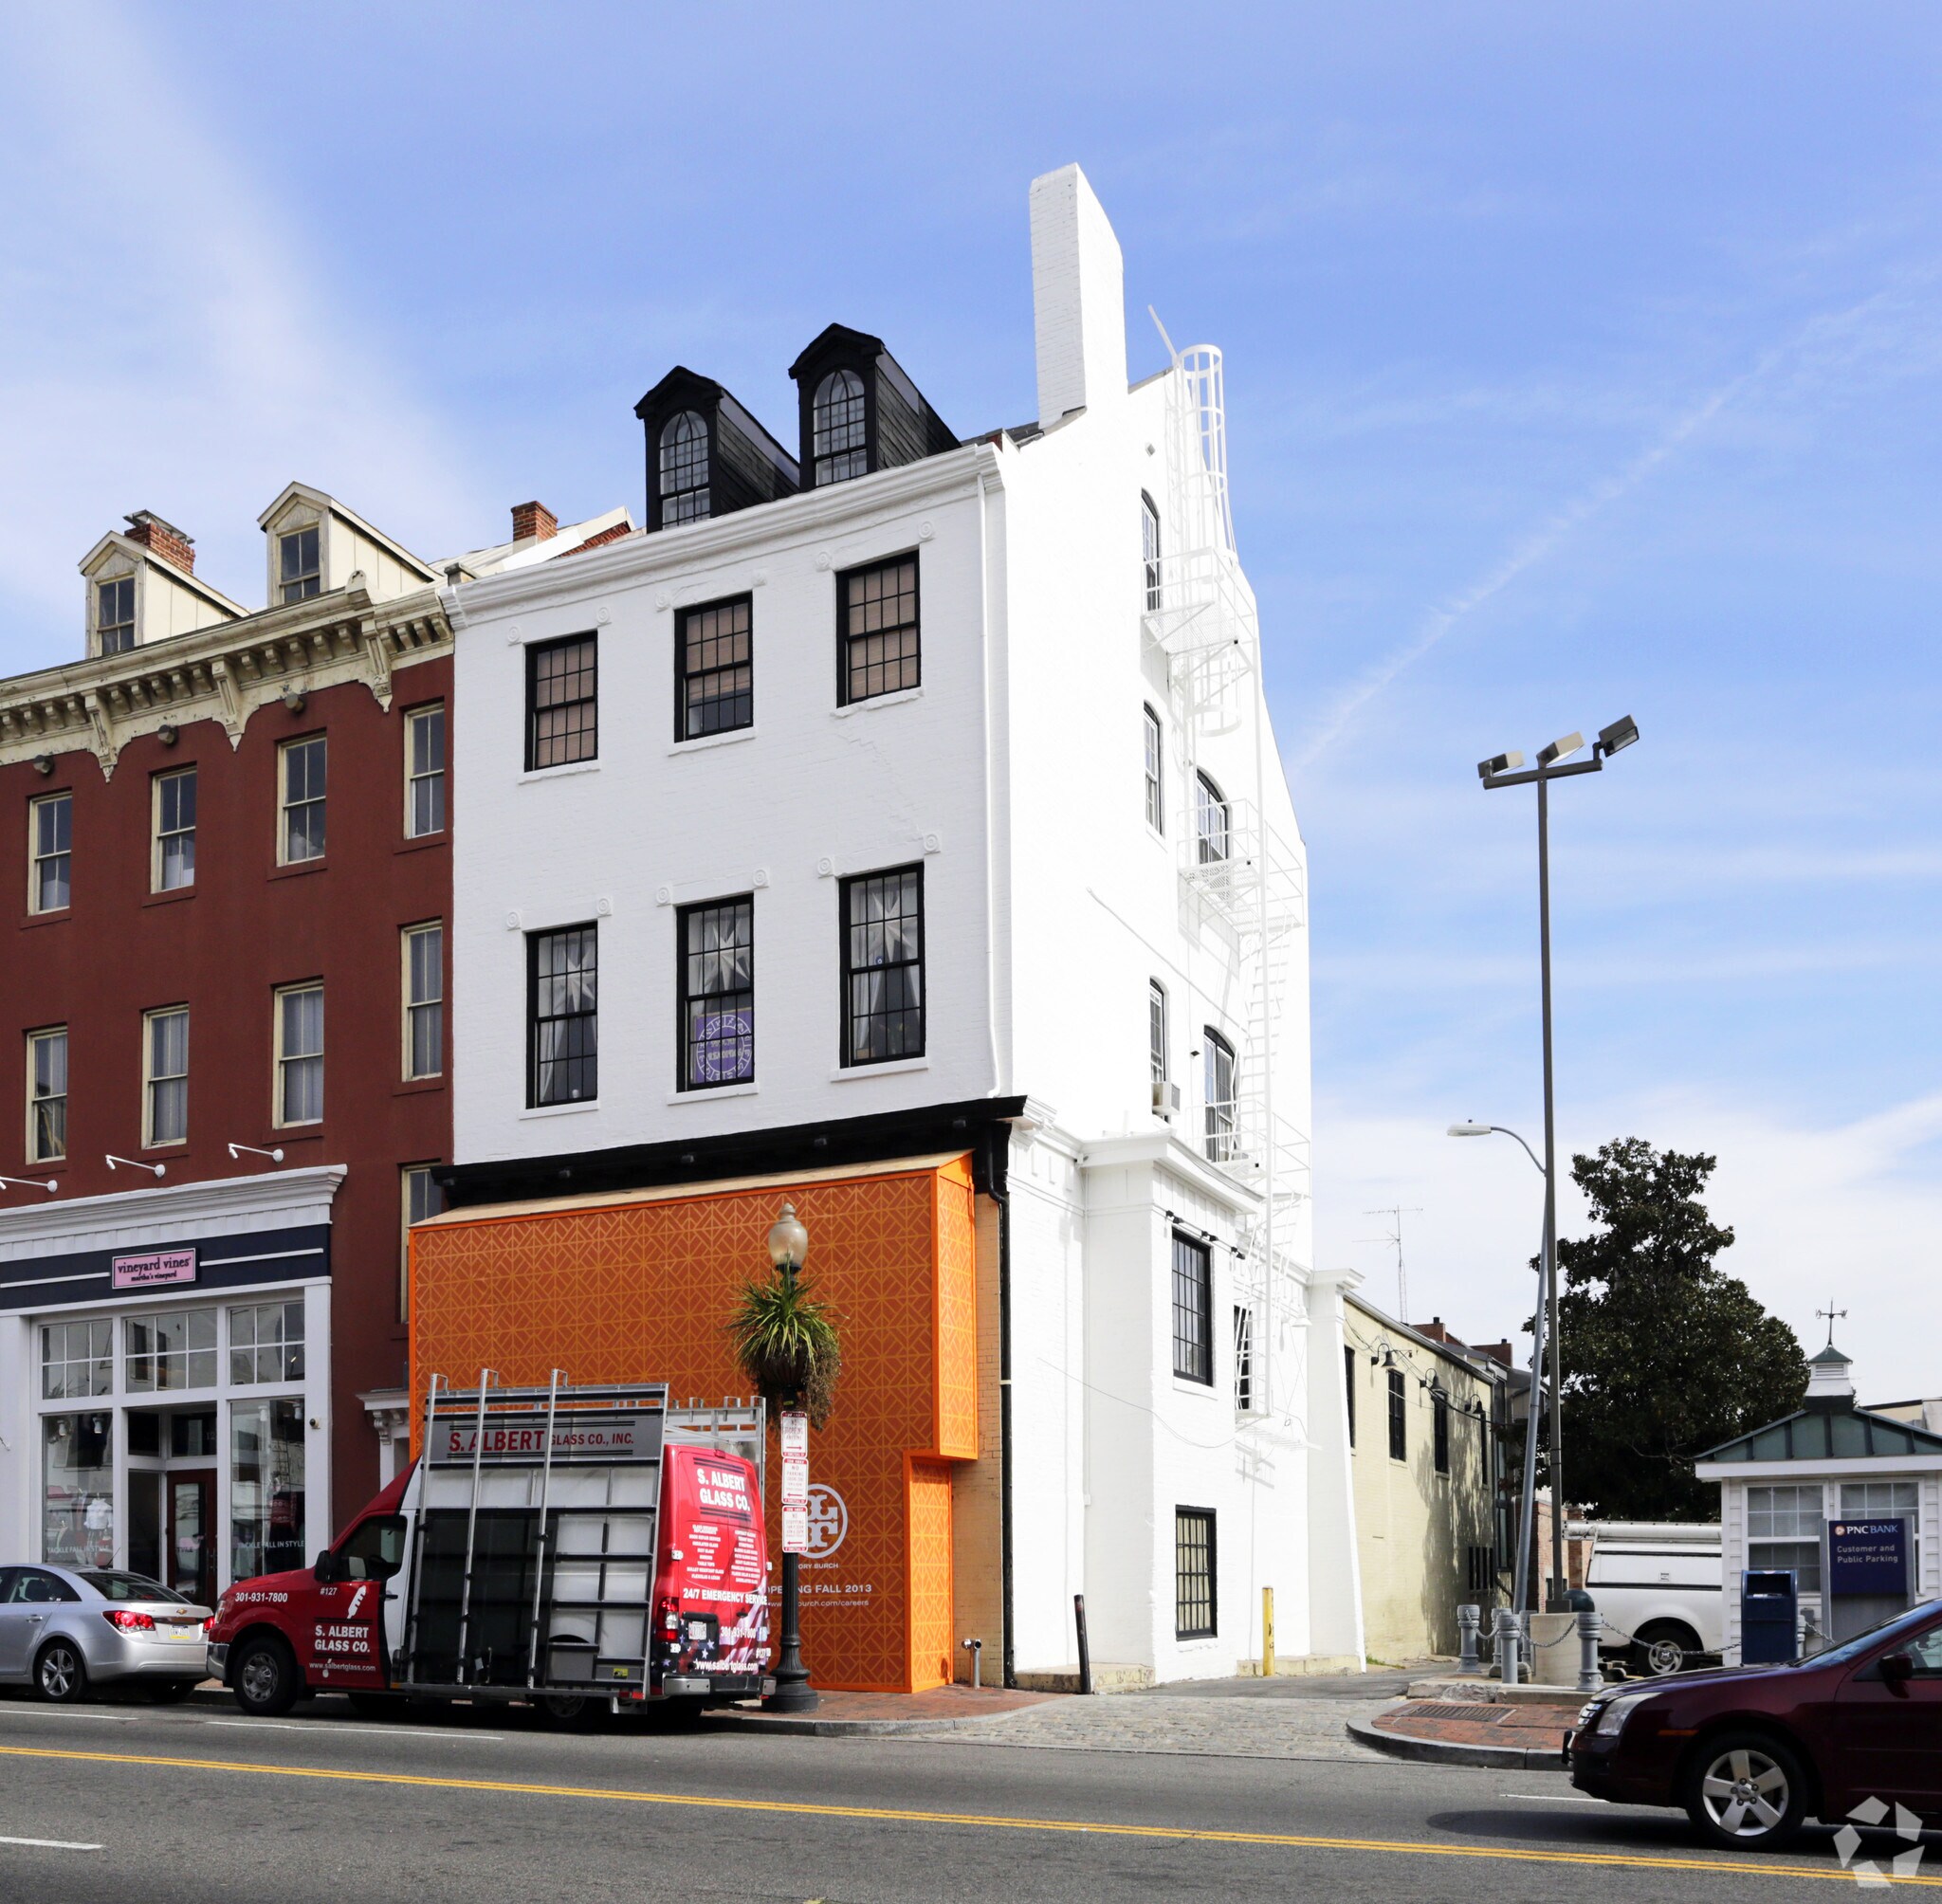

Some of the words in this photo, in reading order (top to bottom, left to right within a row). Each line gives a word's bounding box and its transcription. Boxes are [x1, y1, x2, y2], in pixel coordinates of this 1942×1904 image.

[118, 1256, 160, 1275] vineyard
[131, 1272, 154, 1281] martha's
[155, 1270, 177, 1280] vineyard
[449, 1432, 465, 1452] S.
[612, 1433, 634, 1445] INC.
[697, 1468, 709, 1485] S.
[711, 1471, 745, 1492] ALBERT
[700, 1488, 734, 1508] GLASS
[735, 1494, 751, 1511] CO.
[1846, 1525, 1869, 1534] PNC
[1870, 1525, 1898, 1533] BANK
[1837, 1545, 1878, 1553] Customer
[1879, 1544, 1895, 1552] and
[1865, 1555, 1898, 1564] Parking
[235, 1592, 288, 1602] 301-931-7800
[320, 1587, 338, 1596] #127
[815, 1584, 841, 1593] FALL
[845, 1584, 871, 1593] 2013
[683, 1588, 701, 1600] 24/7
[701, 1589, 744, 1603] EMERGENCY
[745, 1594, 768, 1605] SERVICE
[315, 1625, 325, 1637] S.
[328, 1625, 369, 1639] ALBERT
[315, 1639, 350, 1652] GLASS
[352, 1641, 371, 1653] CO.
[309, 1661, 376, 1672] www.salbertglass.com
